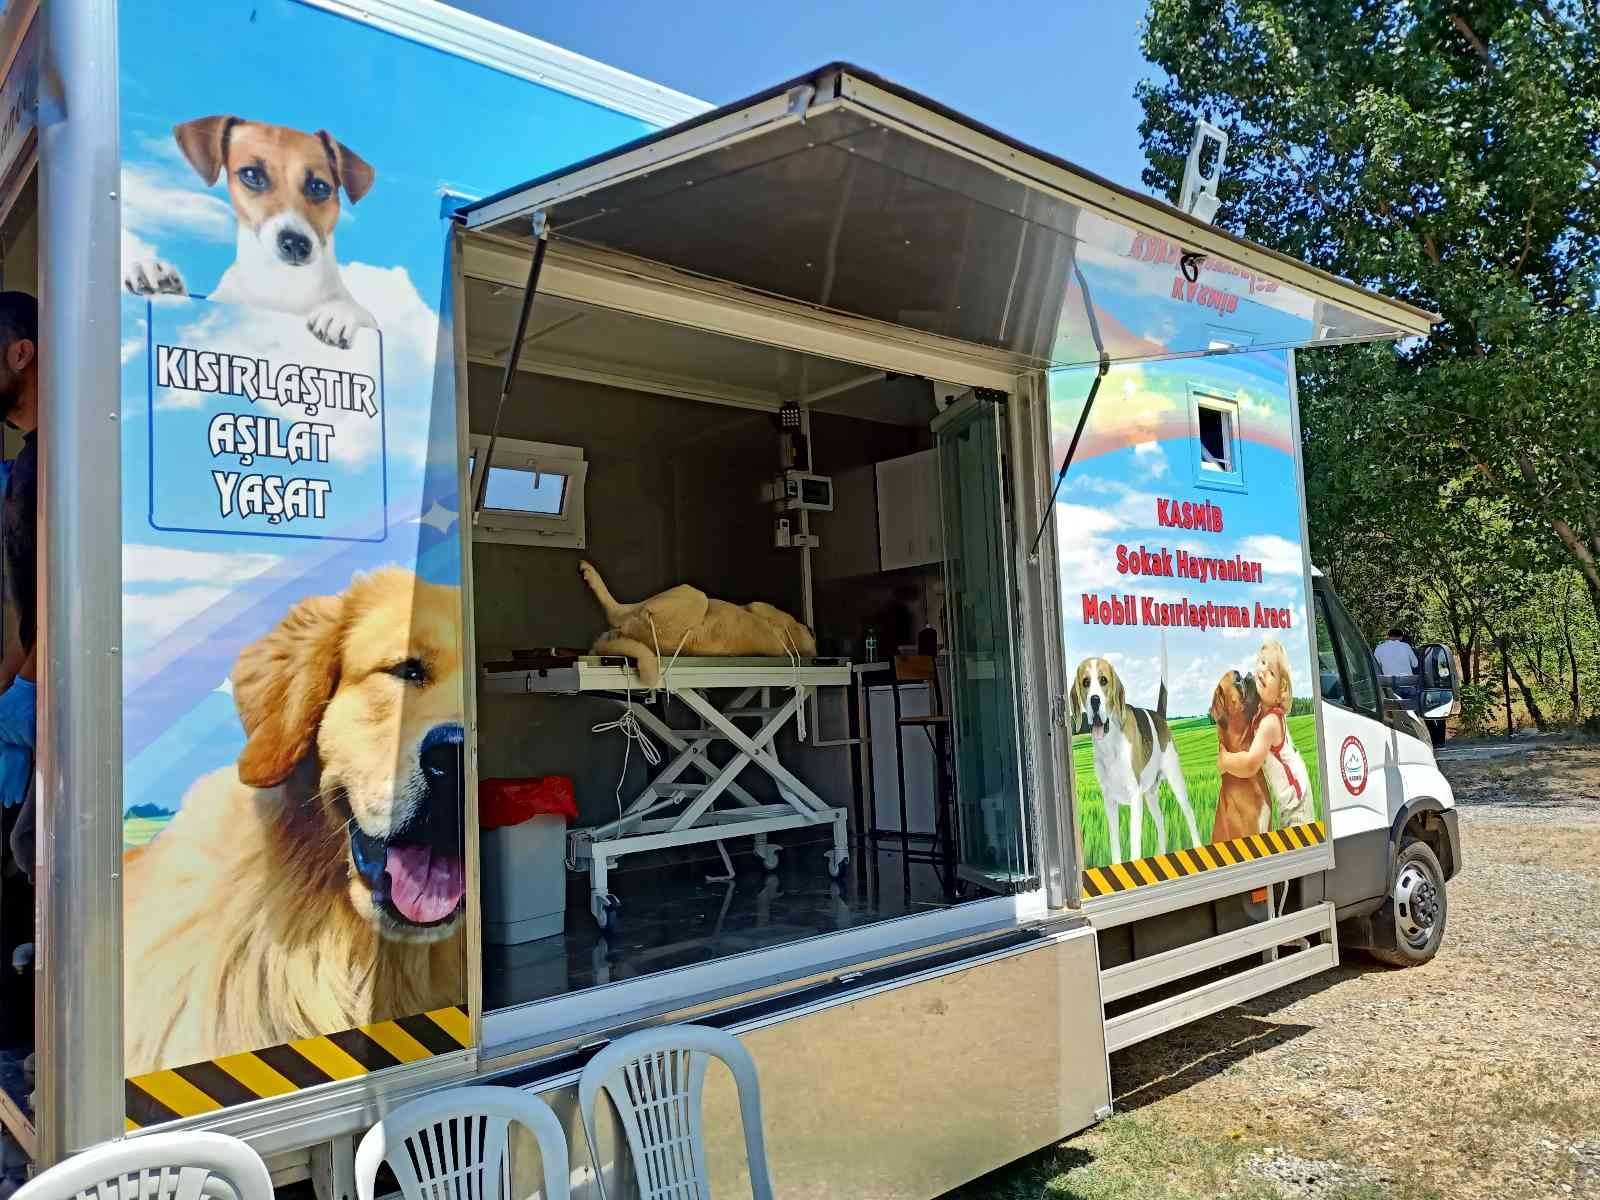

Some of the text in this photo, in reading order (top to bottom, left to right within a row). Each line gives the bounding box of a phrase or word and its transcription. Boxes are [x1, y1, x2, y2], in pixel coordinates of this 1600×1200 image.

[156, 345, 378, 418] KISIRLAŞTIR
[207, 412, 335, 465] AŞILAT
[212, 470, 332, 524] YAŞAT
[1157, 498, 1224, 533] KASMİB
[1116, 544, 1263, 584] Sokak Hayvanları
[1081, 593, 1292, 632] Mobil Kısırlaştırma Aracı
